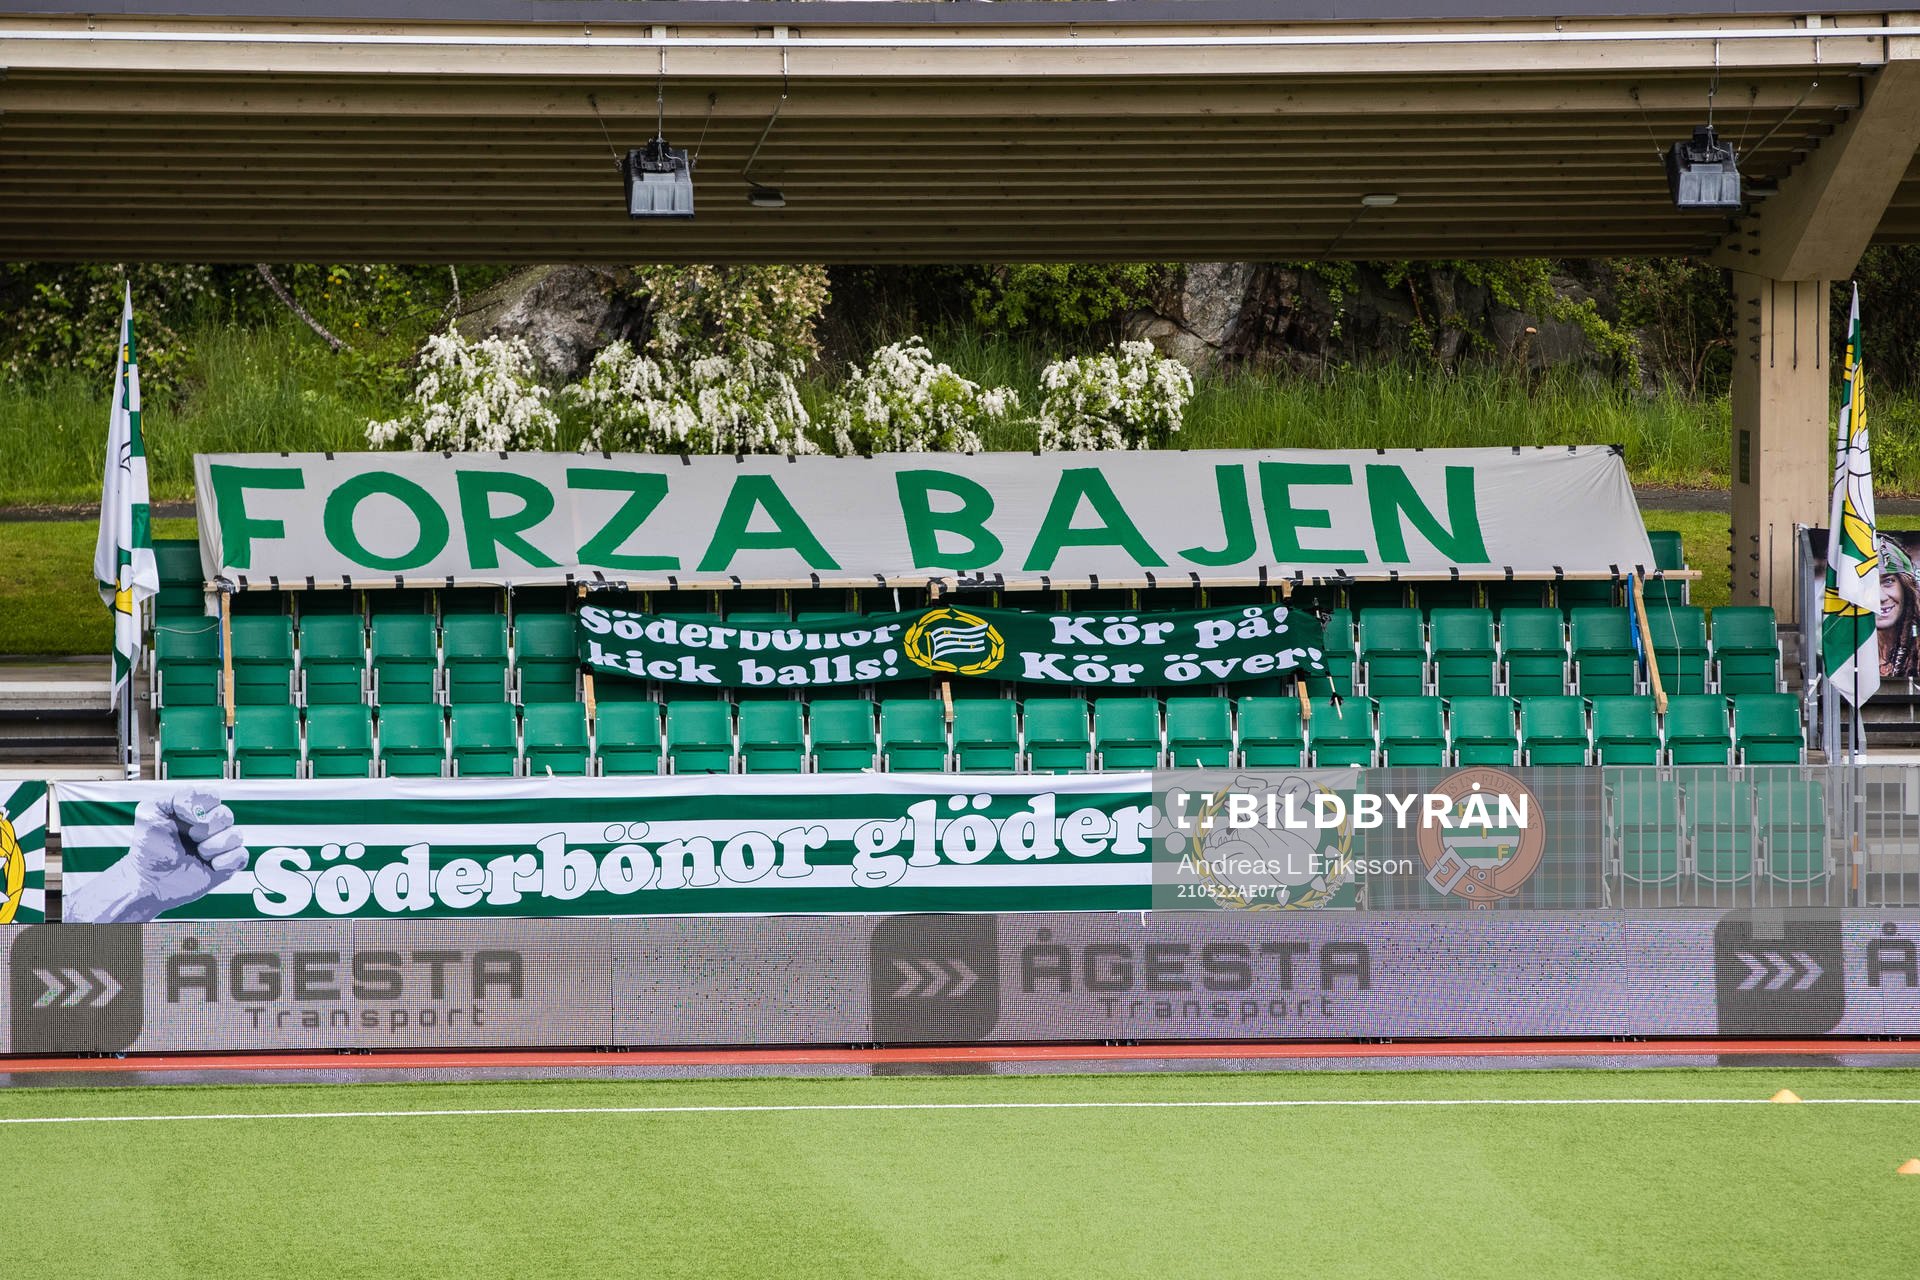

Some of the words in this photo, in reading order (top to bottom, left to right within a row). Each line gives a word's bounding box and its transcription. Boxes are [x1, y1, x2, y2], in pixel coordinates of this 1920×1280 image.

[210, 464, 843, 571] FORZA
[895, 461, 1491, 571] BAJEN
[1049, 615, 1175, 646] Kör
[1193, 606, 1289, 649] på!
[587, 640, 722, 684] kick
[738, 648, 898, 686] balls!
[1019, 651, 1145, 683] Kör
[1163, 647, 1325, 683] över!
[252, 821, 829, 916] Söderbönor
[851, 787, 1188, 888] glöder!
[165, 937, 526, 1003] ÅGESTA
[1020, 928, 1372, 993] ÅGESTA
[244, 1005, 485, 1032] Transport
[1099, 996, 1334, 1024] Transport
